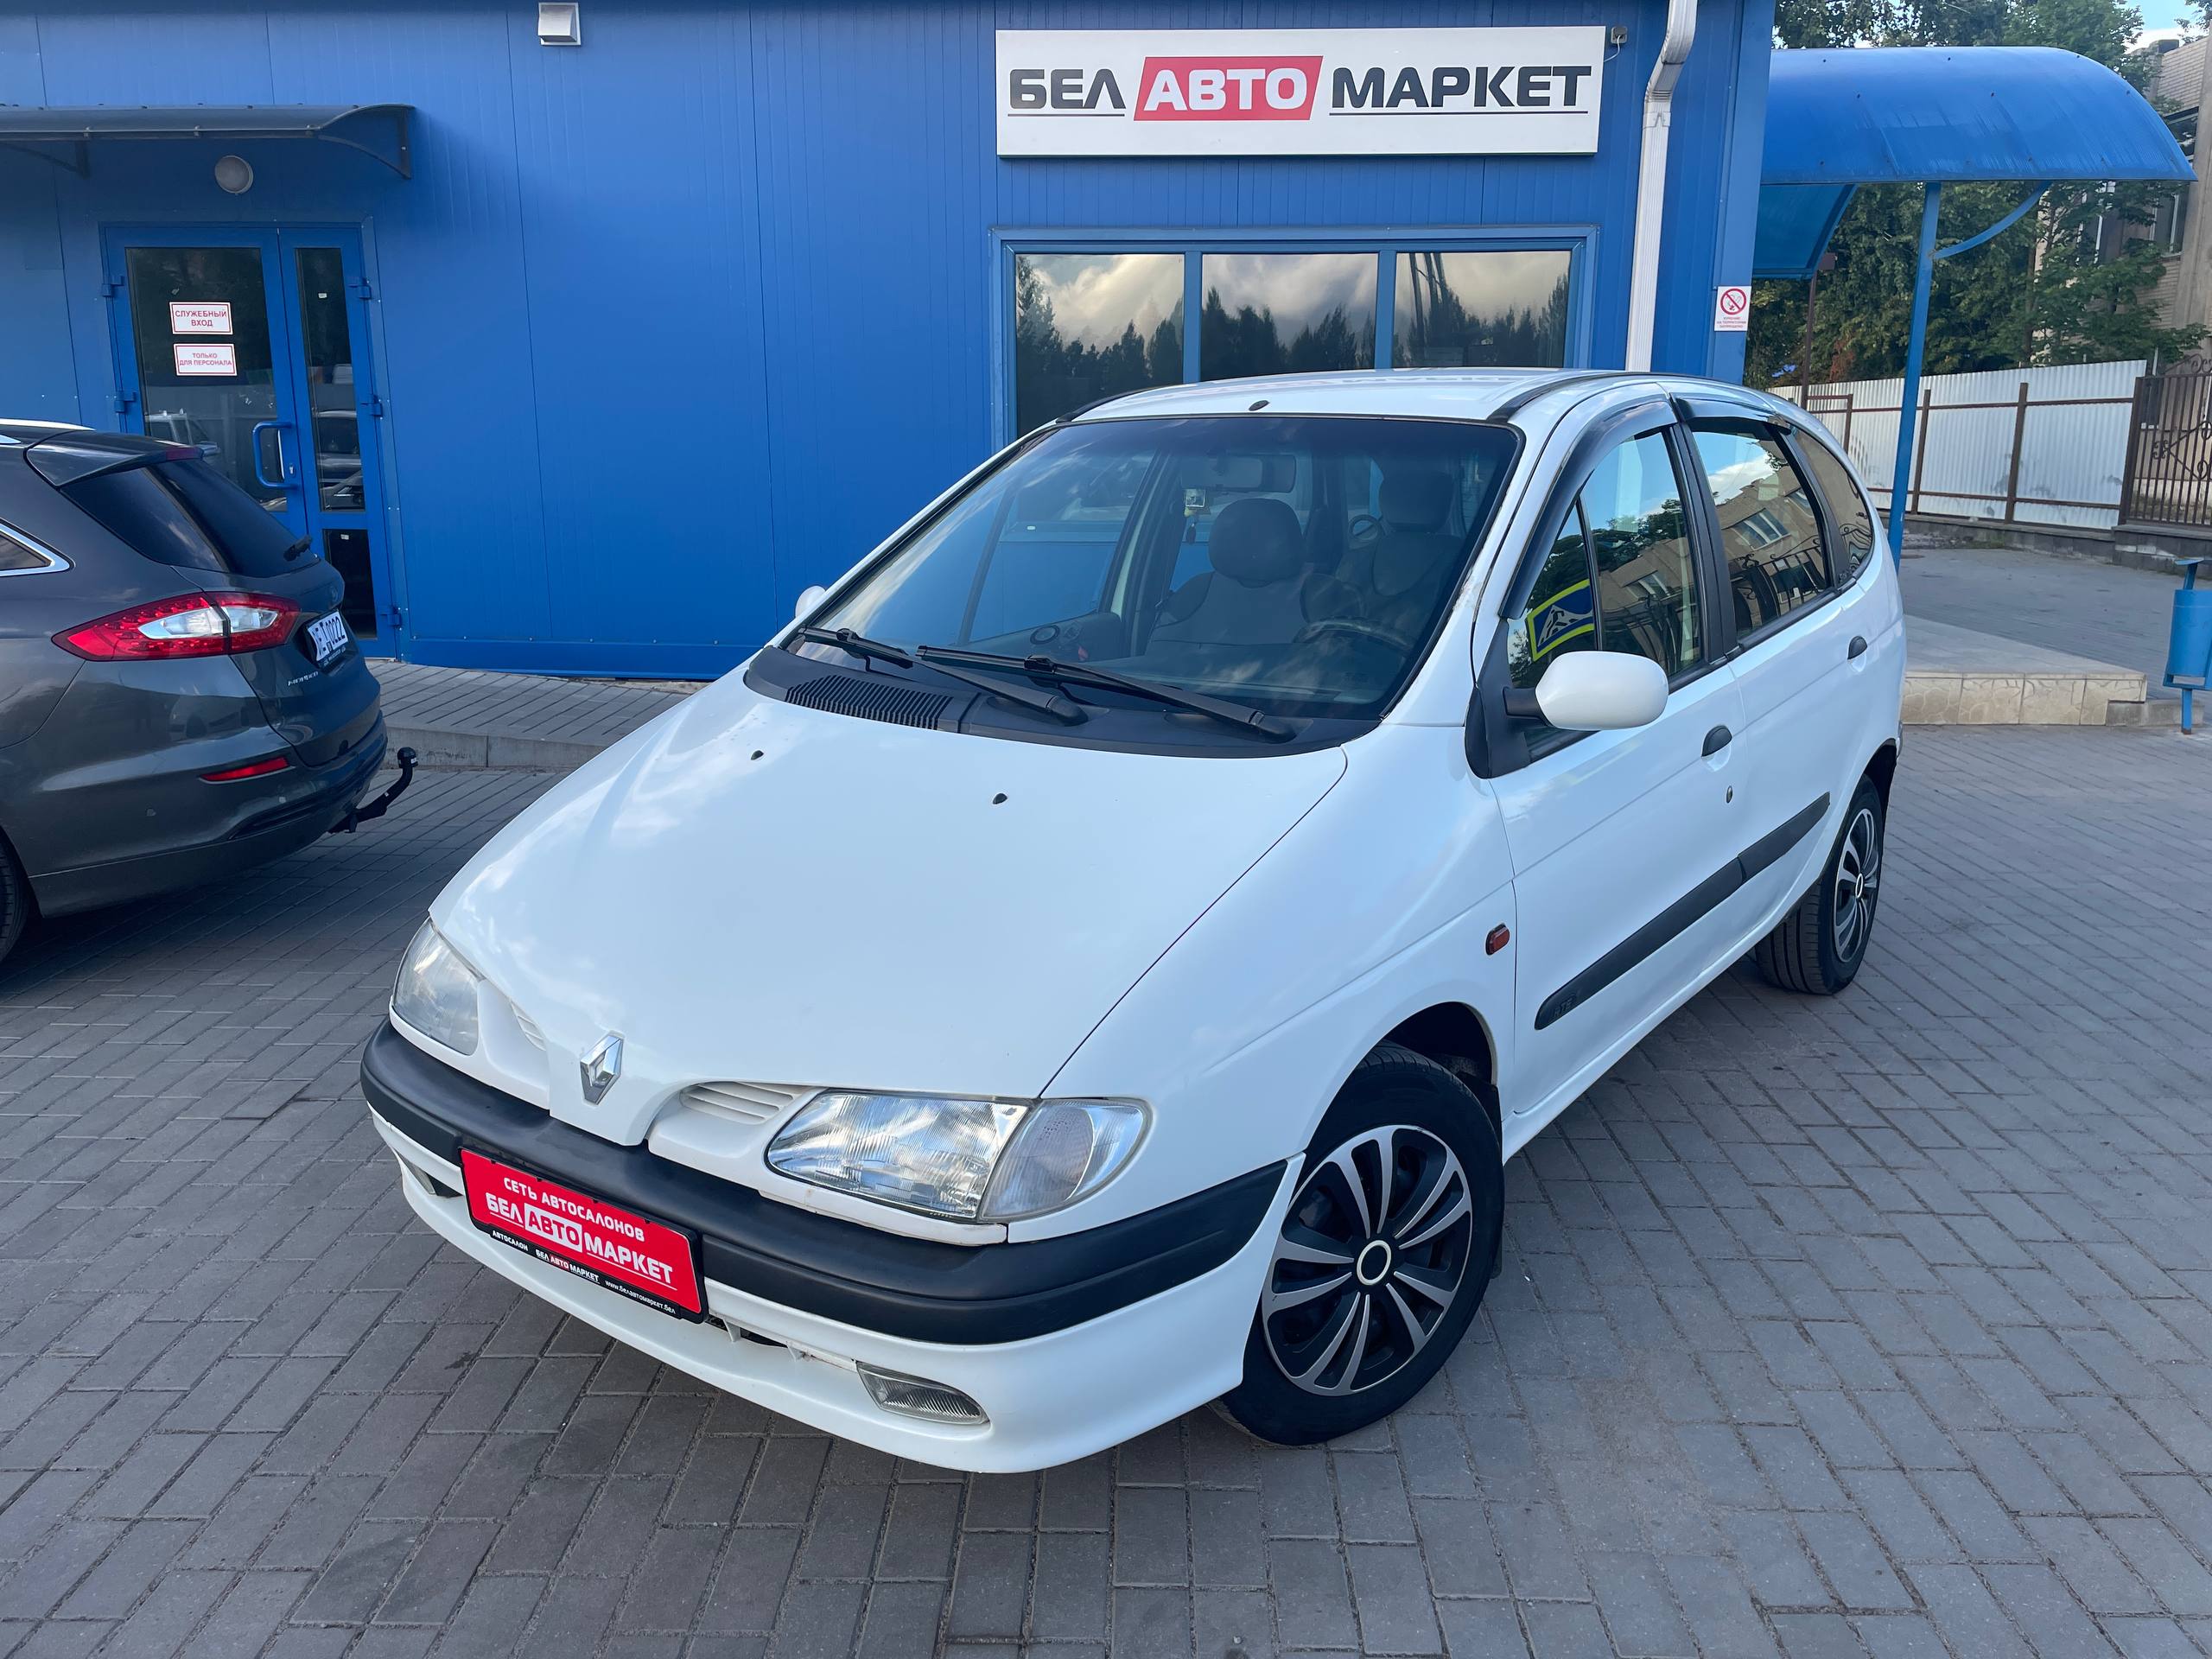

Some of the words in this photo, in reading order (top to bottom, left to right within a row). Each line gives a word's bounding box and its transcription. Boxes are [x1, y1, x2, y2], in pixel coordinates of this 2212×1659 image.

[1007, 67, 1127, 111] БЕЛ
[1143, 67, 1309, 112] АВТО
[1332, 65, 1592, 110] МАРКЕТ
[175, 308, 227, 317] СЛУЖЕБНЫЙ
[504, 1177, 537, 1201] СЕТЬ
[541, 1192, 645, 1243] АВТОСАЛОНОВ
[485, 1192, 524, 1224] БЕЛ
[528, 1210, 581, 1246] АВТО
[583, 1231, 674, 1285] МАРКЕТ
[492, 1230, 529, 1252] АВТОСАЛОН
[535, 1249, 550, 1262] БЕЛ
[550, 1256, 569, 1269] АВТО
[569, 1263, 600, 1282] МАРКЕТ
